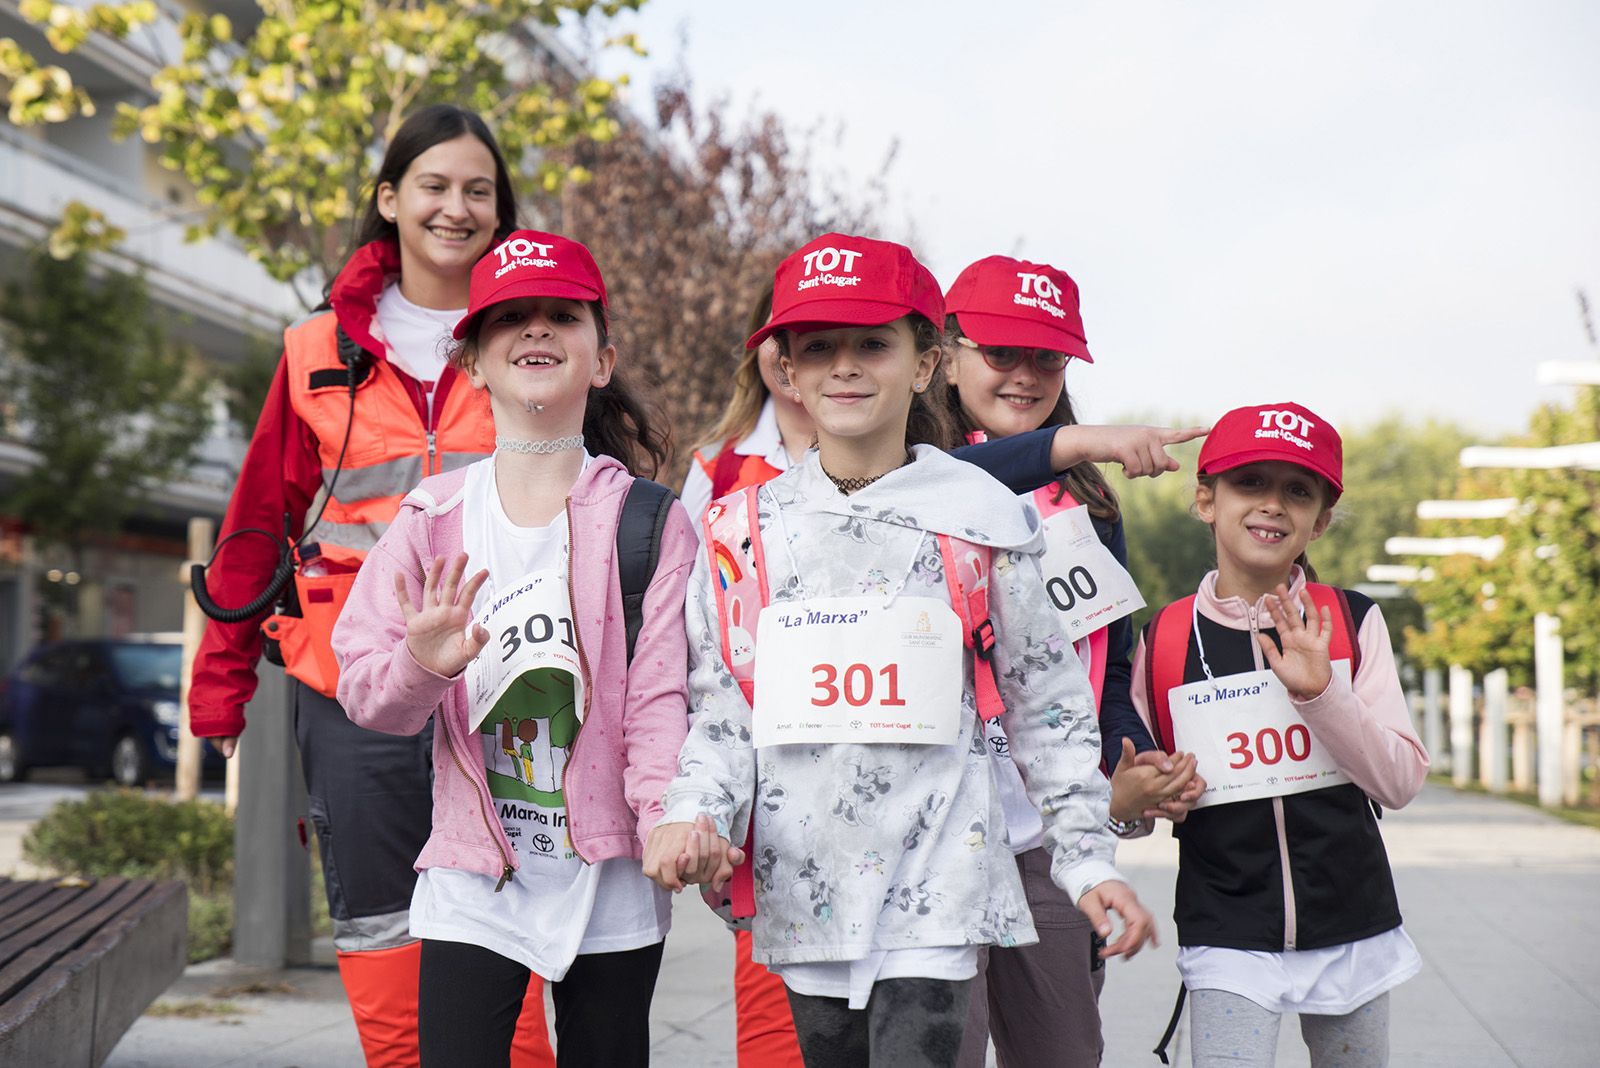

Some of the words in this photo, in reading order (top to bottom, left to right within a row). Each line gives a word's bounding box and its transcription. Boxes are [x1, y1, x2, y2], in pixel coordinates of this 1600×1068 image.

[493, 238, 554, 266] TOT
[803, 247, 863, 276] TOT
[495, 259, 517, 279] Sant
[521, 257, 558, 268] Cugat
[797, 275, 820, 291] Sant
[824, 273, 861, 287] Cugat
[1016, 272, 1063, 305] TOT
[1013, 293, 1037, 308] Sant
[1258, 410, 1315, 438] TOT
[1254, 429, 1280, 439] Sant
[1283, 431, 1314, 451] Cugat
[806, 610, 868, 625] Marxa”
[499, 613, 578, 663] 301
[810, 663, 907, 708] 301
[1187, 693, 1211, 706] “La
[1215, 682, 1269, 701] Marxa”
[1226, 723, 1312, 770] 300
[500, 803, 548, 825] Marxa
